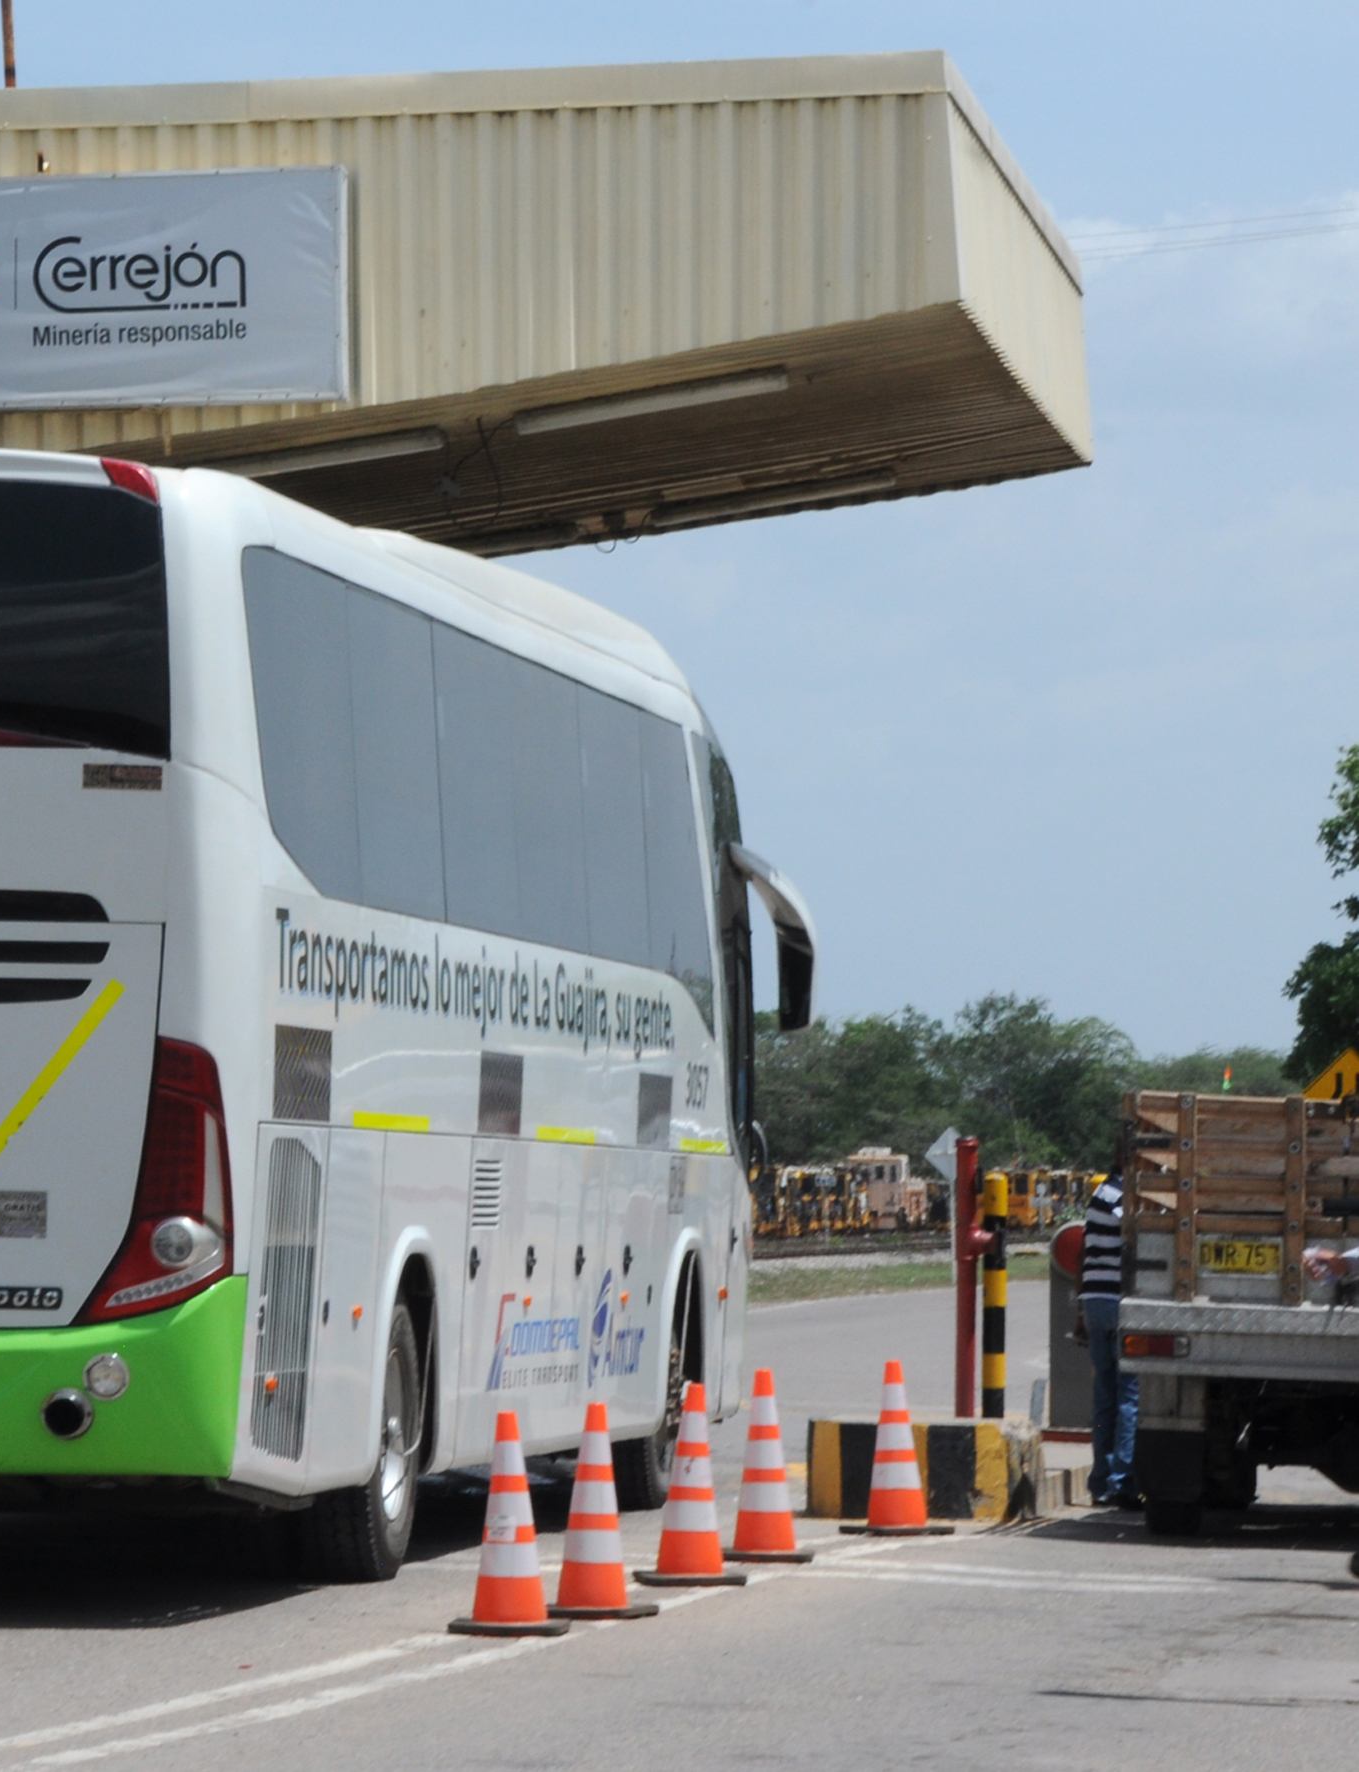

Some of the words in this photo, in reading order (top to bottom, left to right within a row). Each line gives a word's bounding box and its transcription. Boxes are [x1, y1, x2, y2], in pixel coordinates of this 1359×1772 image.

[33, 236, 246, 313] Cerrejón
[32, 321, 111, 348] Minería
[118, 319, 247, 347] responsable
[276, 908, 430, 1020] Transportamos
[435, 933, 451, 1015] lo
[454, 945, 506, 1039] mejor
[509, 949, 530, 1029] de
[534, 959, 551, 1029] La
[555, 962, 611, 1054] Guajira,
[616, 991, 631, 1044] su
[686, 1062, 710, 1110] 3057
[502, 1367, 529, 1390] ELITE
[531, 1363, 580, 1386] TRANSPORT
